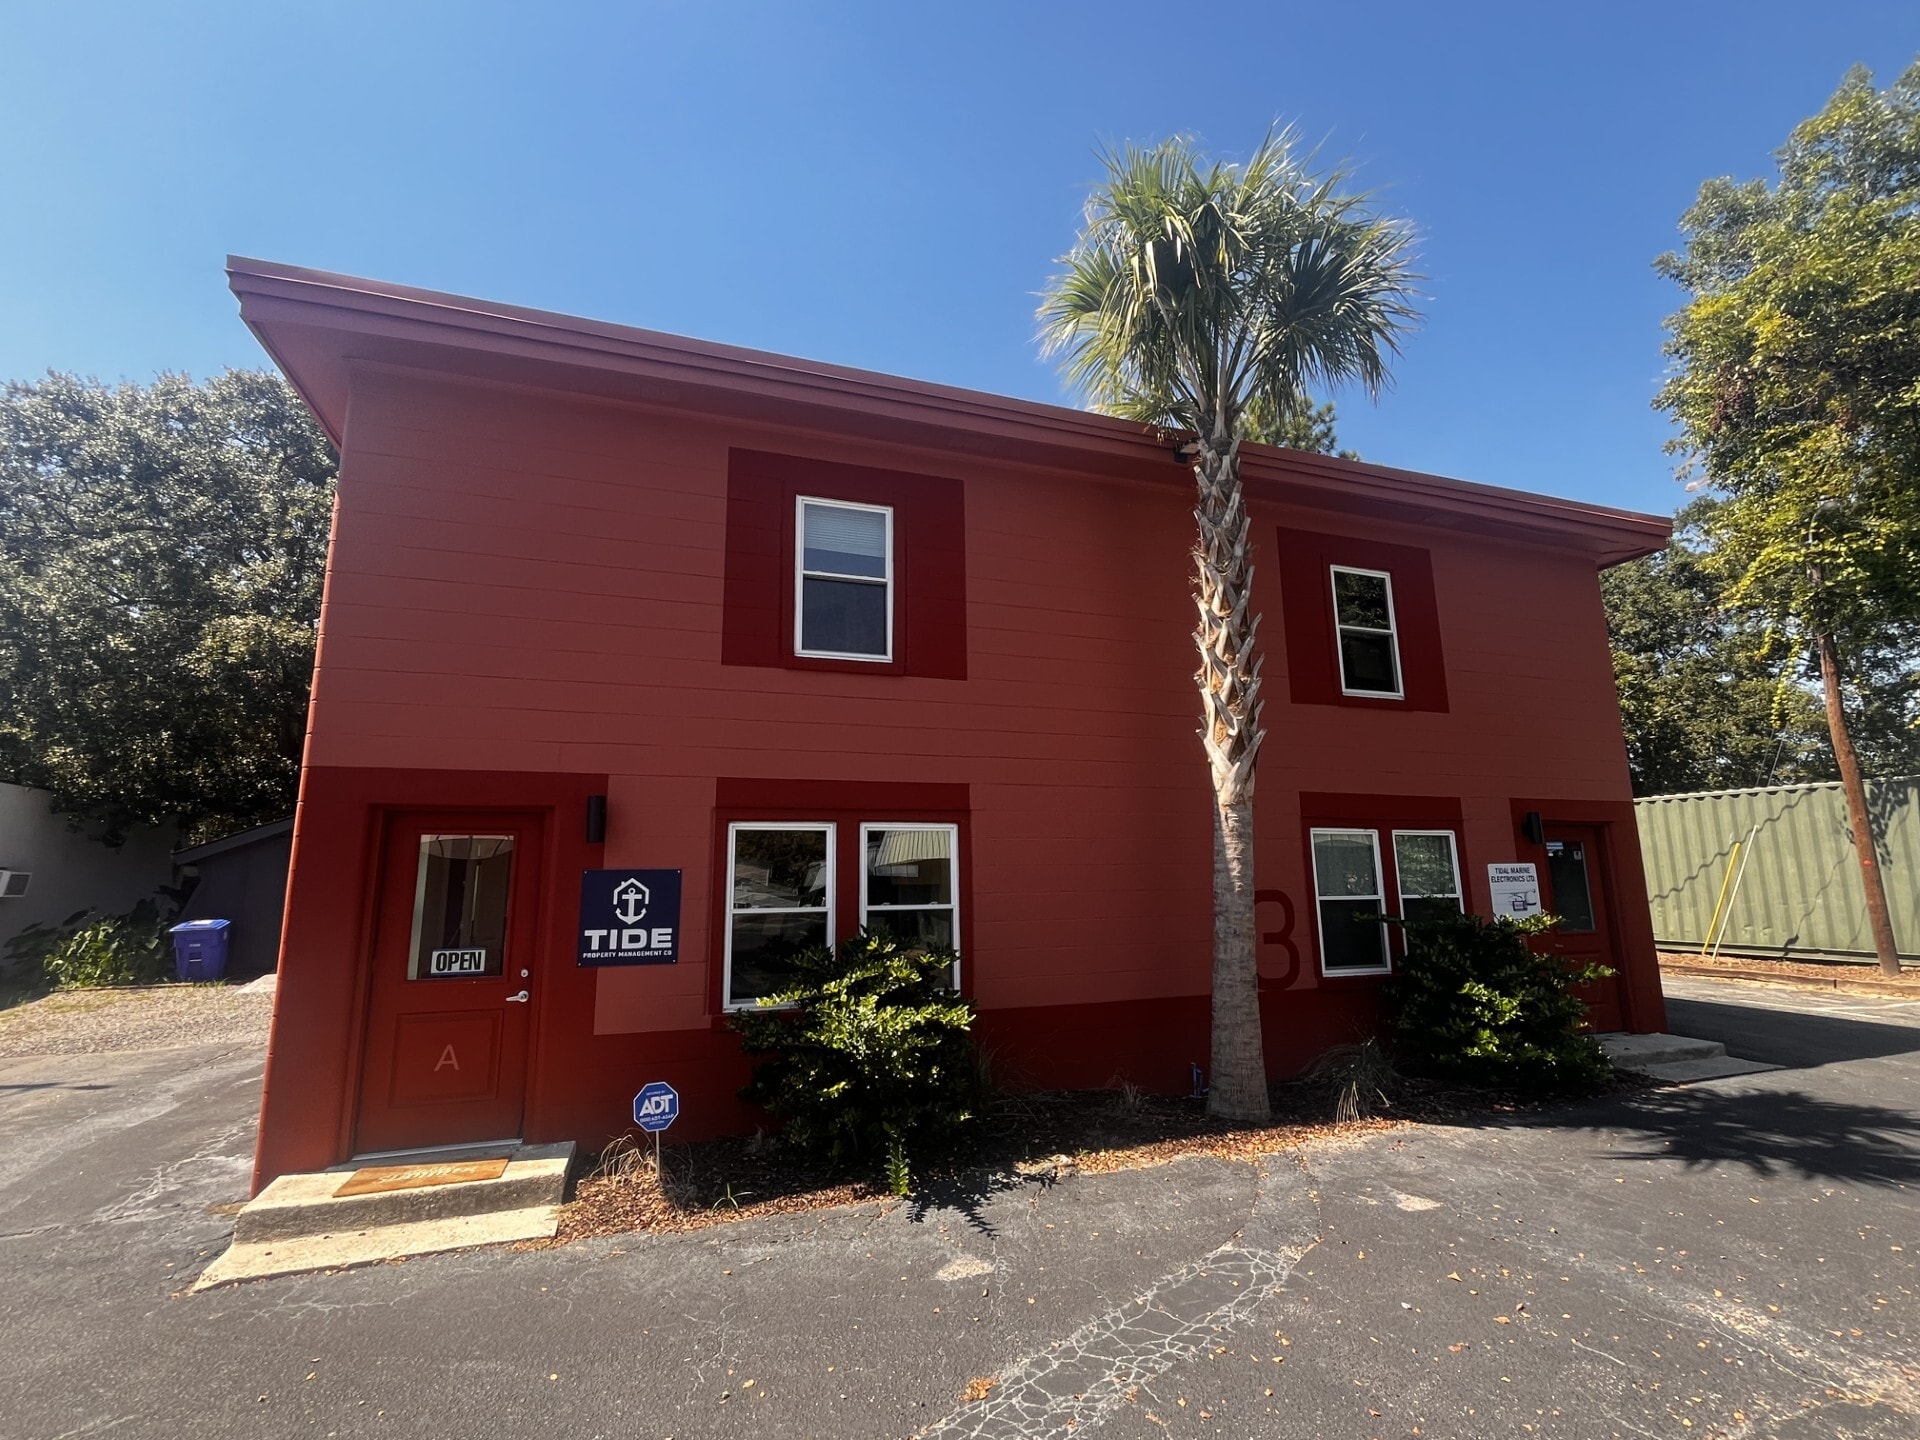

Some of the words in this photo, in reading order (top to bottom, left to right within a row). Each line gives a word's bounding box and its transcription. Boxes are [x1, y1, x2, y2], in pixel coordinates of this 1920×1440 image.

[1490, 875, 1526, 883] ELECTRONICS
[1495, 867, 1509, 875] TIDAL
[584, 928, 672, 951] TIDE
[435, 951, 482, 972] OPEN
[582, 951, 617, 959] PROPERTY
[618, 949, 662, 957] MANAGEMENT
[434, 1043, 460, 1072] A
[639, 1094, 674, 1117] ADT
